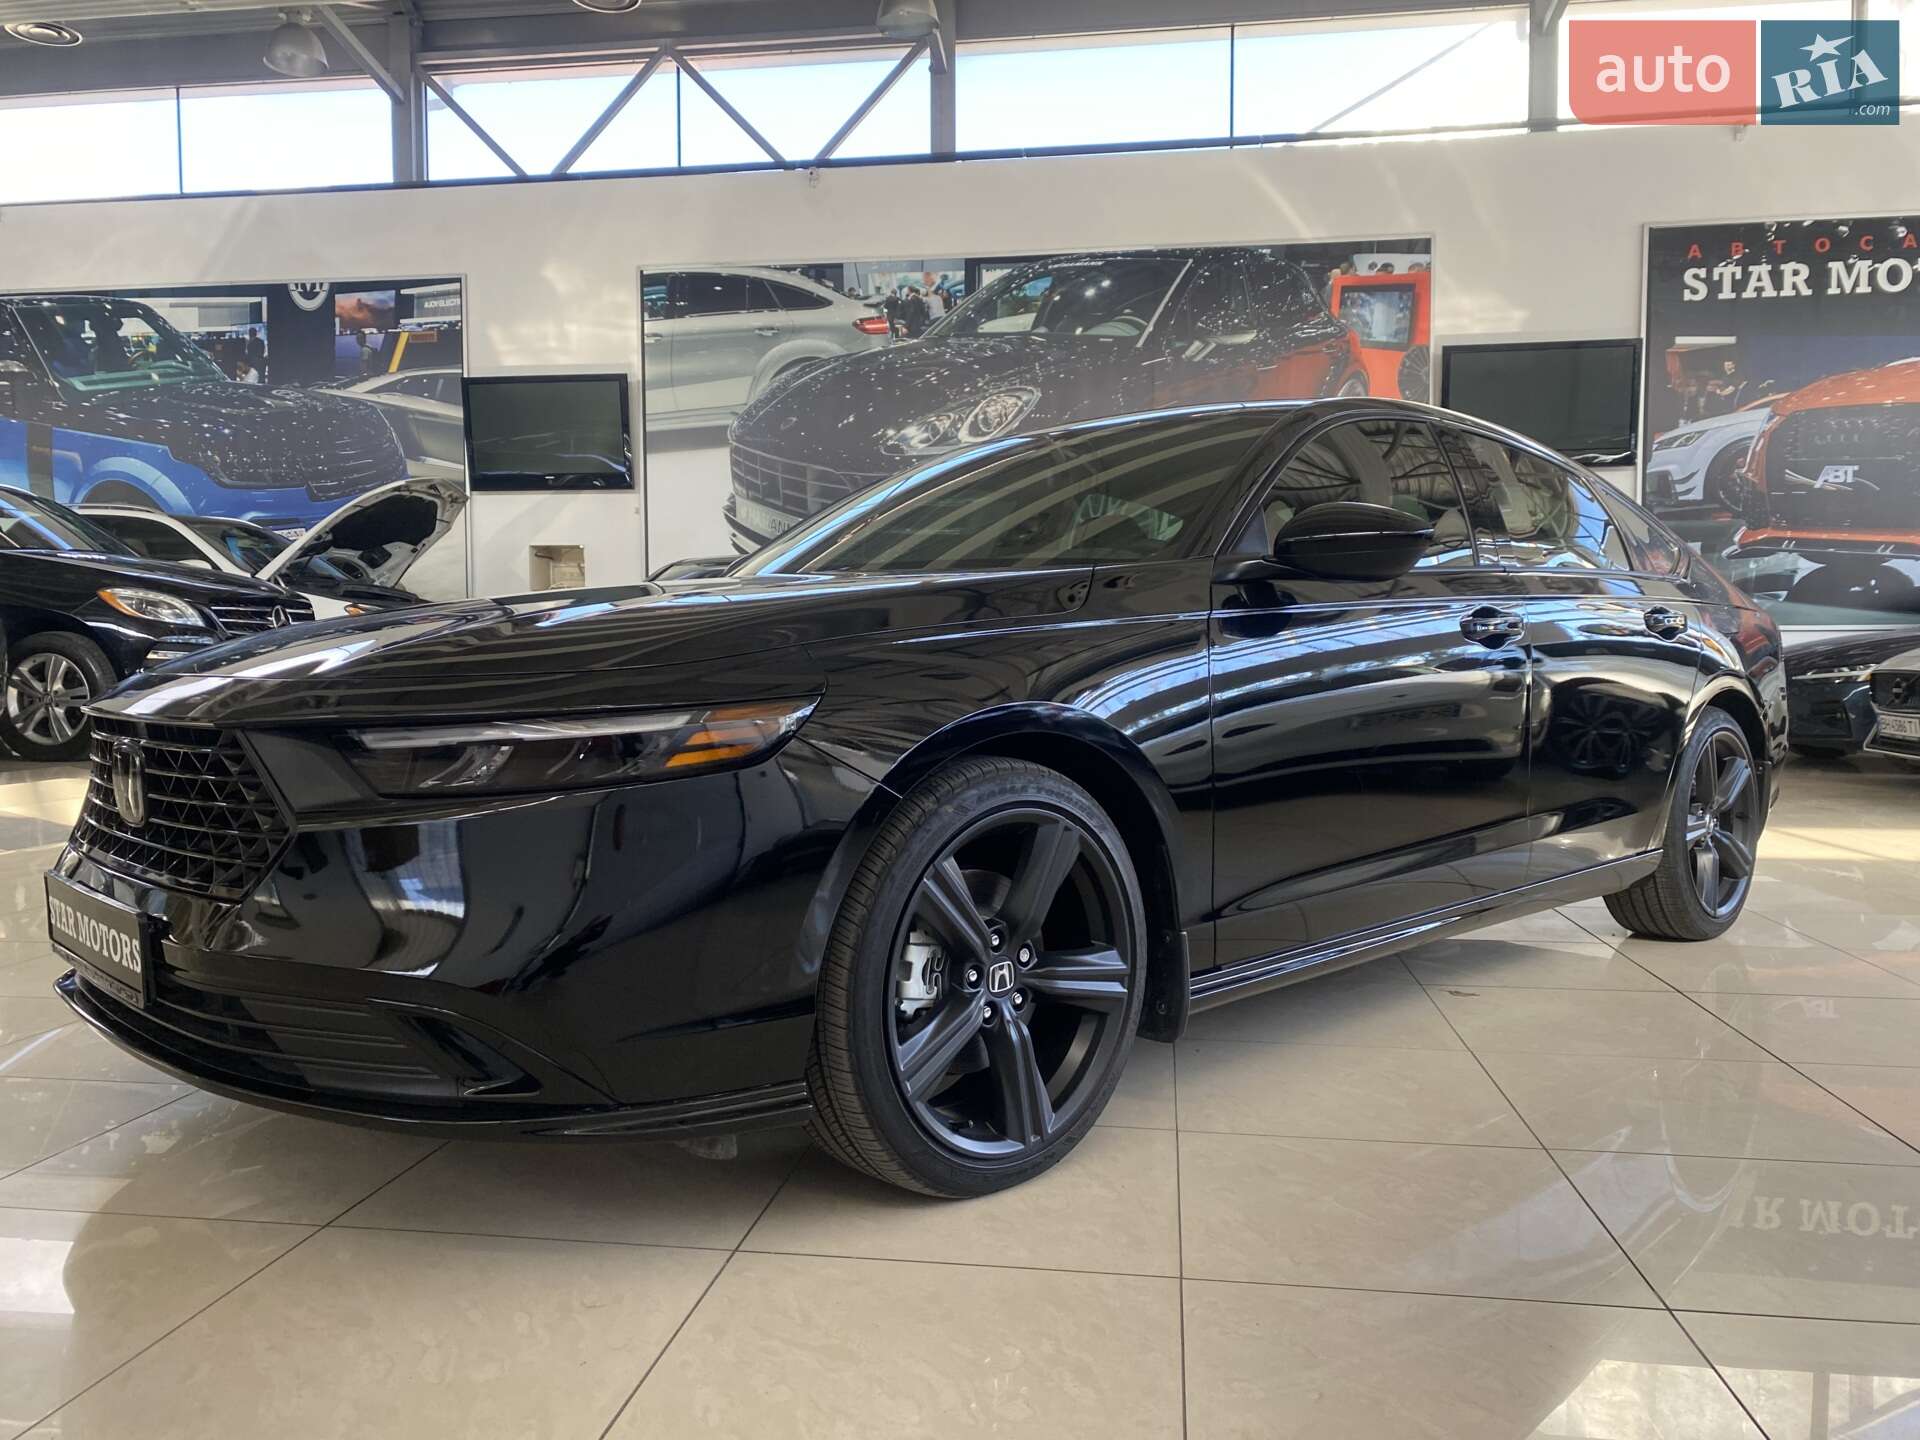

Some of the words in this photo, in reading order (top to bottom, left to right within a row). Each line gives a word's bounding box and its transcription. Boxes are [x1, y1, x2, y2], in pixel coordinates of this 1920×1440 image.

[1683, 261, 1813, 301] STAR
[1827, 257, 1920, 295] MO
[1814, 464, 1860, 488] ABT
[49, 895, 77, 939] STAR
[76, 911, 142, 973] MOTORS
